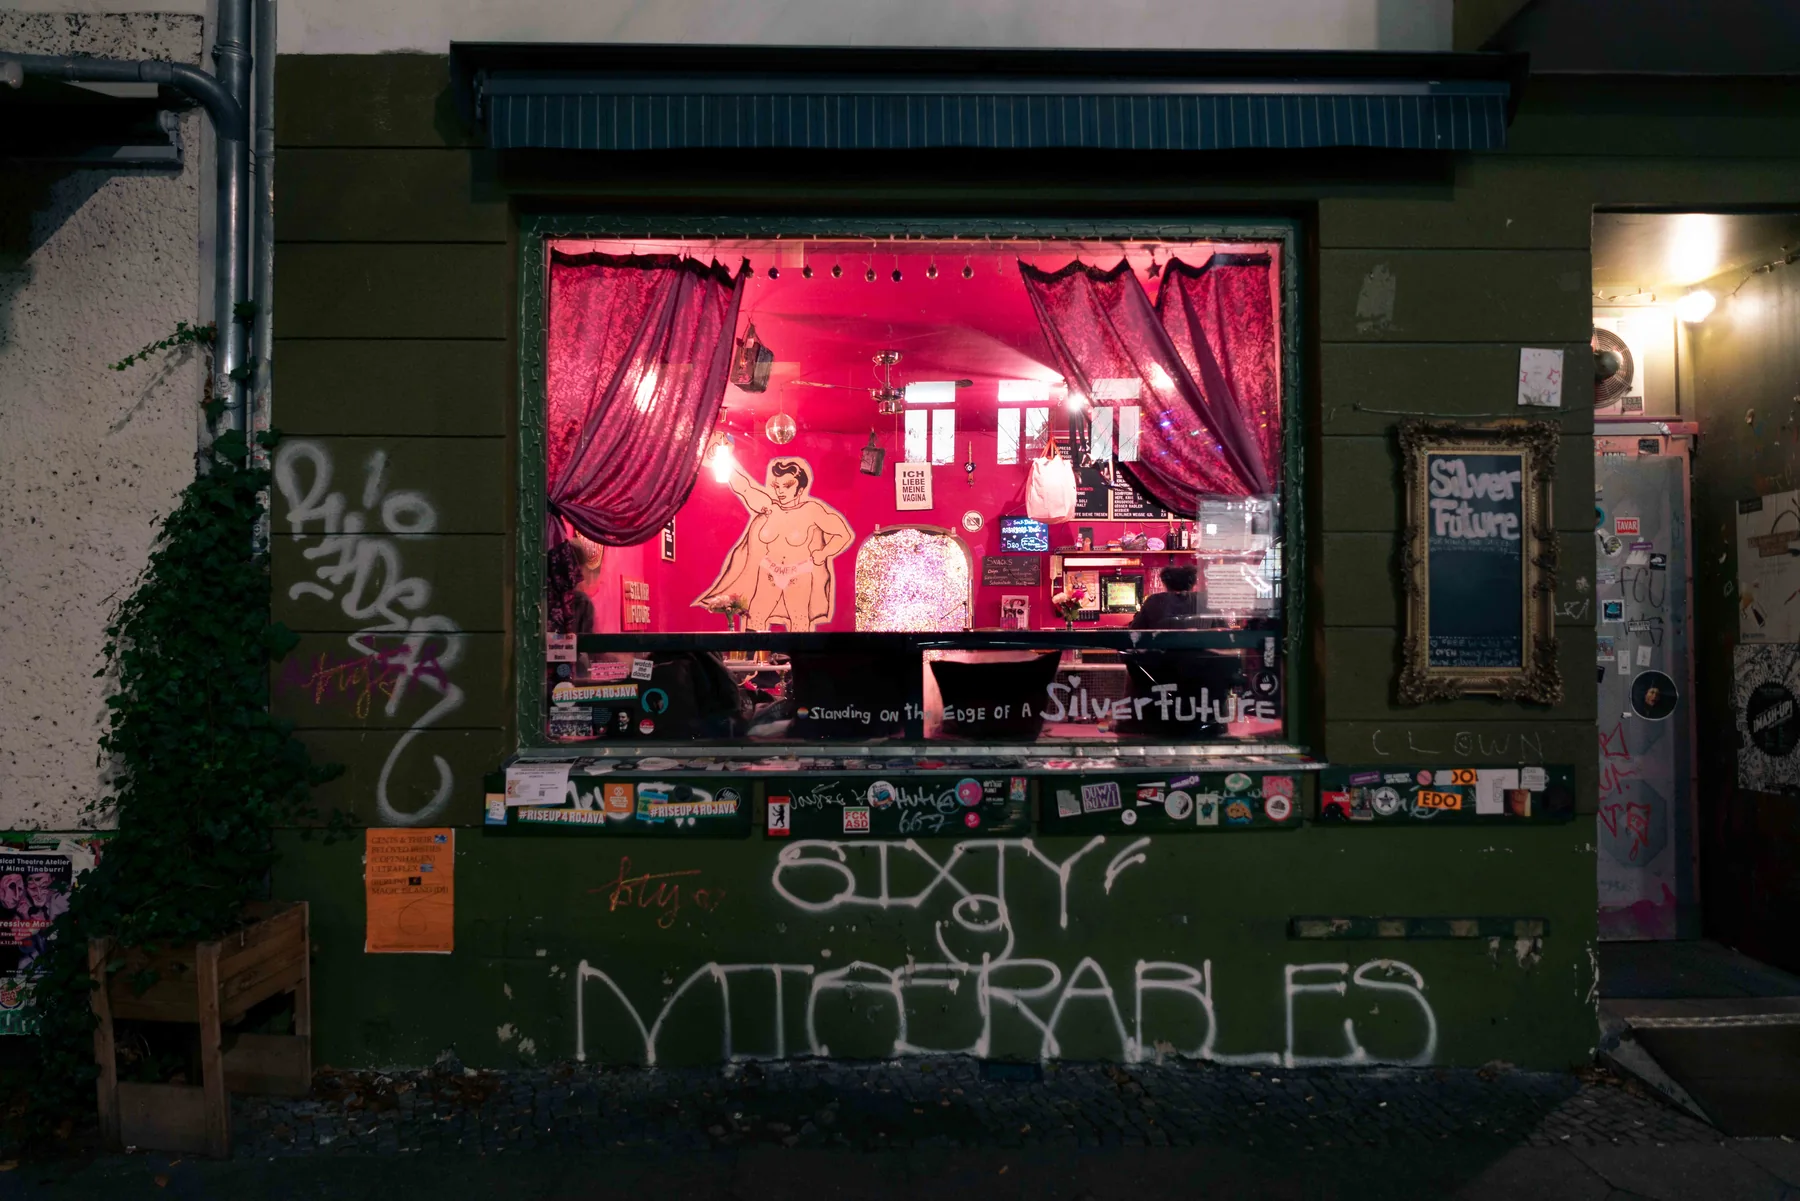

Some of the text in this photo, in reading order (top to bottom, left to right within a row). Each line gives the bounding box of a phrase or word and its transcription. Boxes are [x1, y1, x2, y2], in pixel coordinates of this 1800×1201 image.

[902, 478, 926, 486] LIEBE
[1430, 459, 1522, 500] Silver
[902, 493, 927, 502] VAGINA
[1430, 499, 1520, 539] Future
[769, 563, 797, 574] POWER
[1022, 702, 1032, 718] A
[1422, 792, 1457, 808] EDO
[845, 811, 867, 820] FCK
